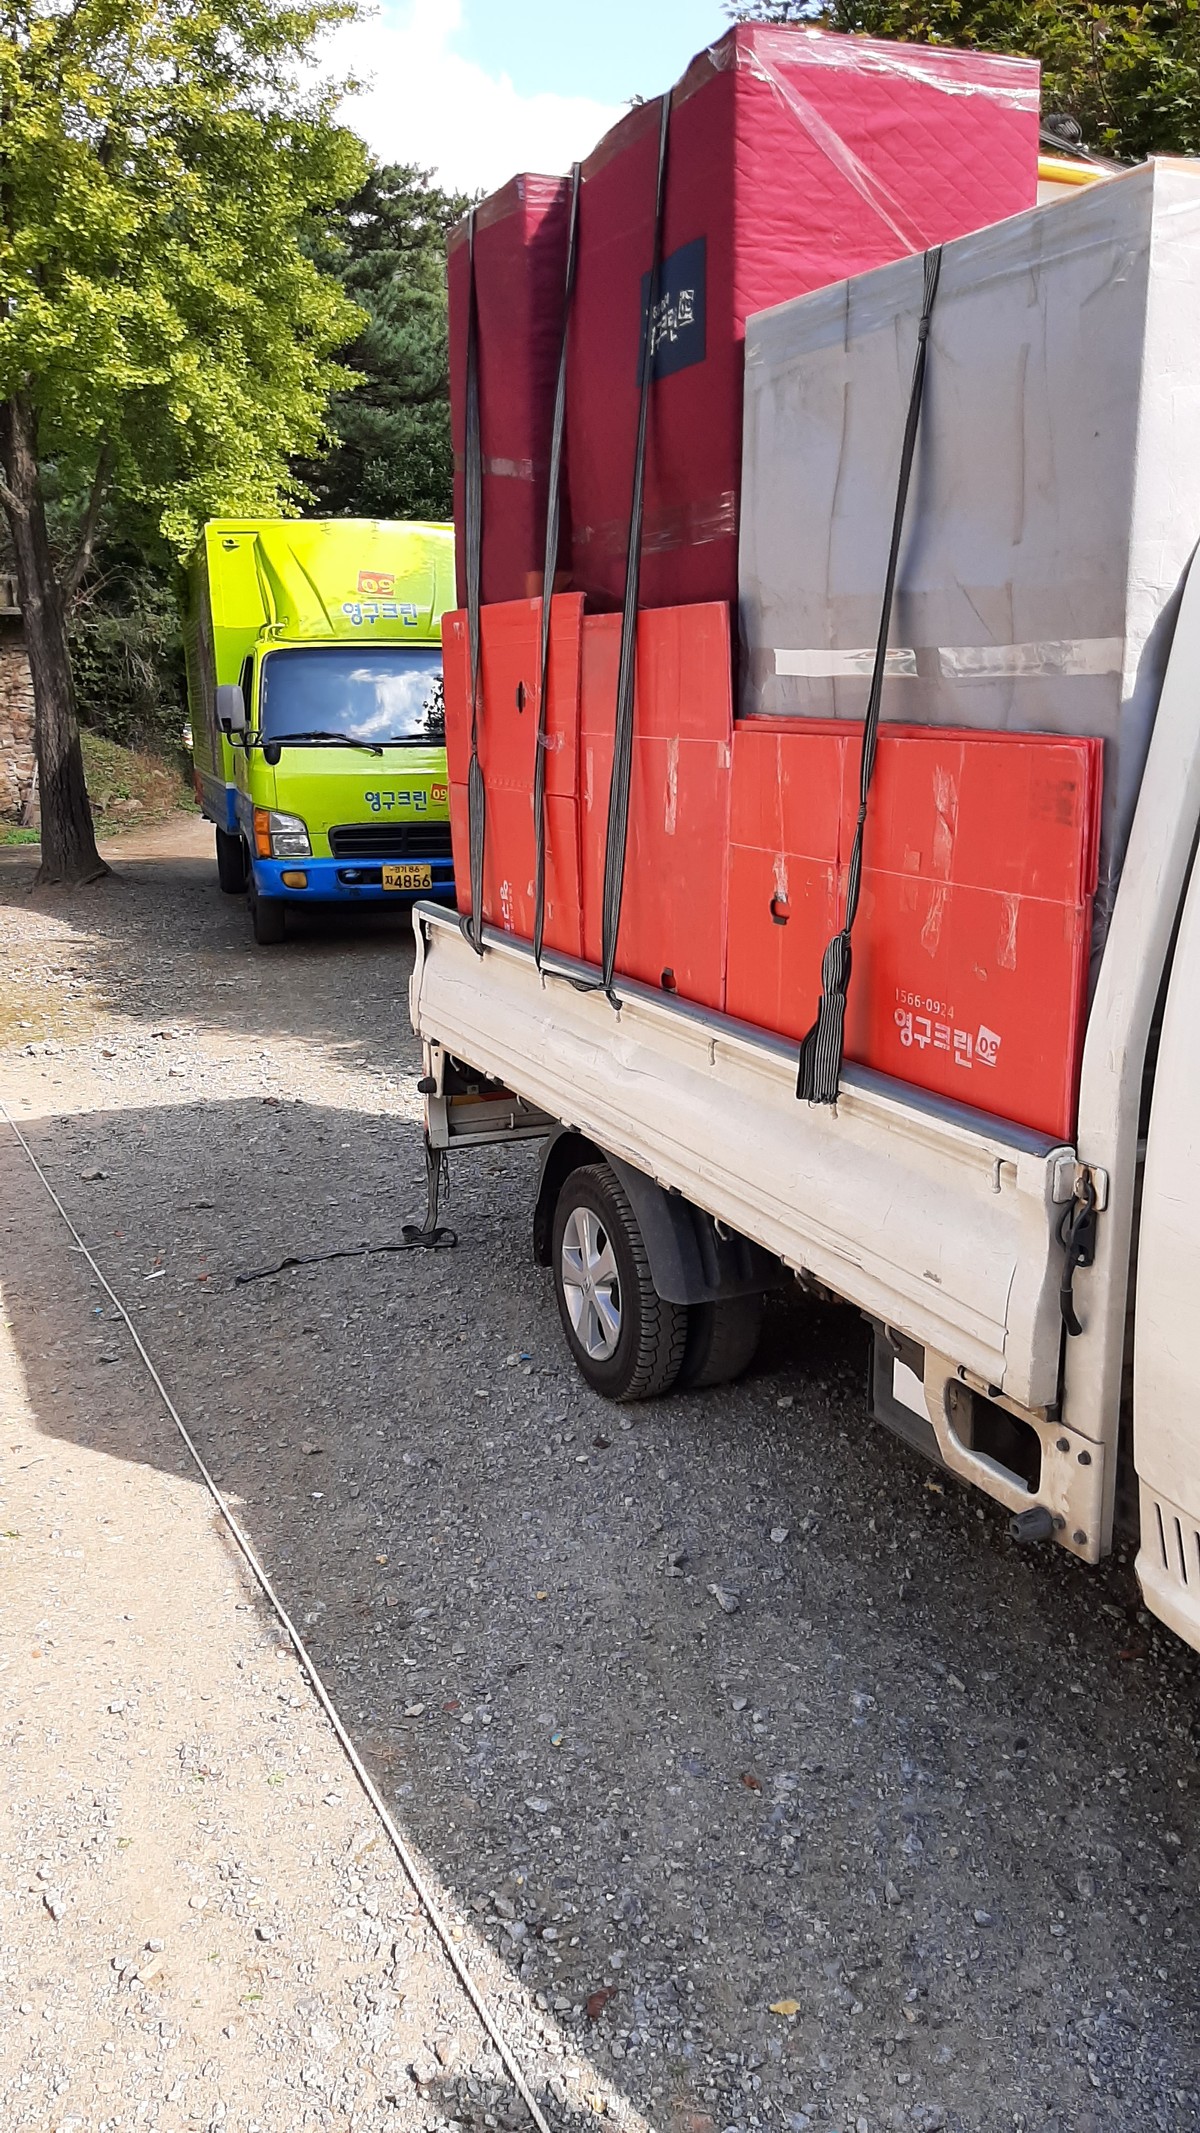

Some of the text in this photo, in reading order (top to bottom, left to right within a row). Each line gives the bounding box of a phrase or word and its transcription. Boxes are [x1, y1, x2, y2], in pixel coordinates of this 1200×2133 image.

[360, 576, 394, 594] 09
[342, 602, 418, 626] 영구크린
[364, 786, 448, 812] 영구크린 09
[894, 986, 955, 1019] 1566-0924
[893, 1007, 1000, 1069] 영구크린 09
